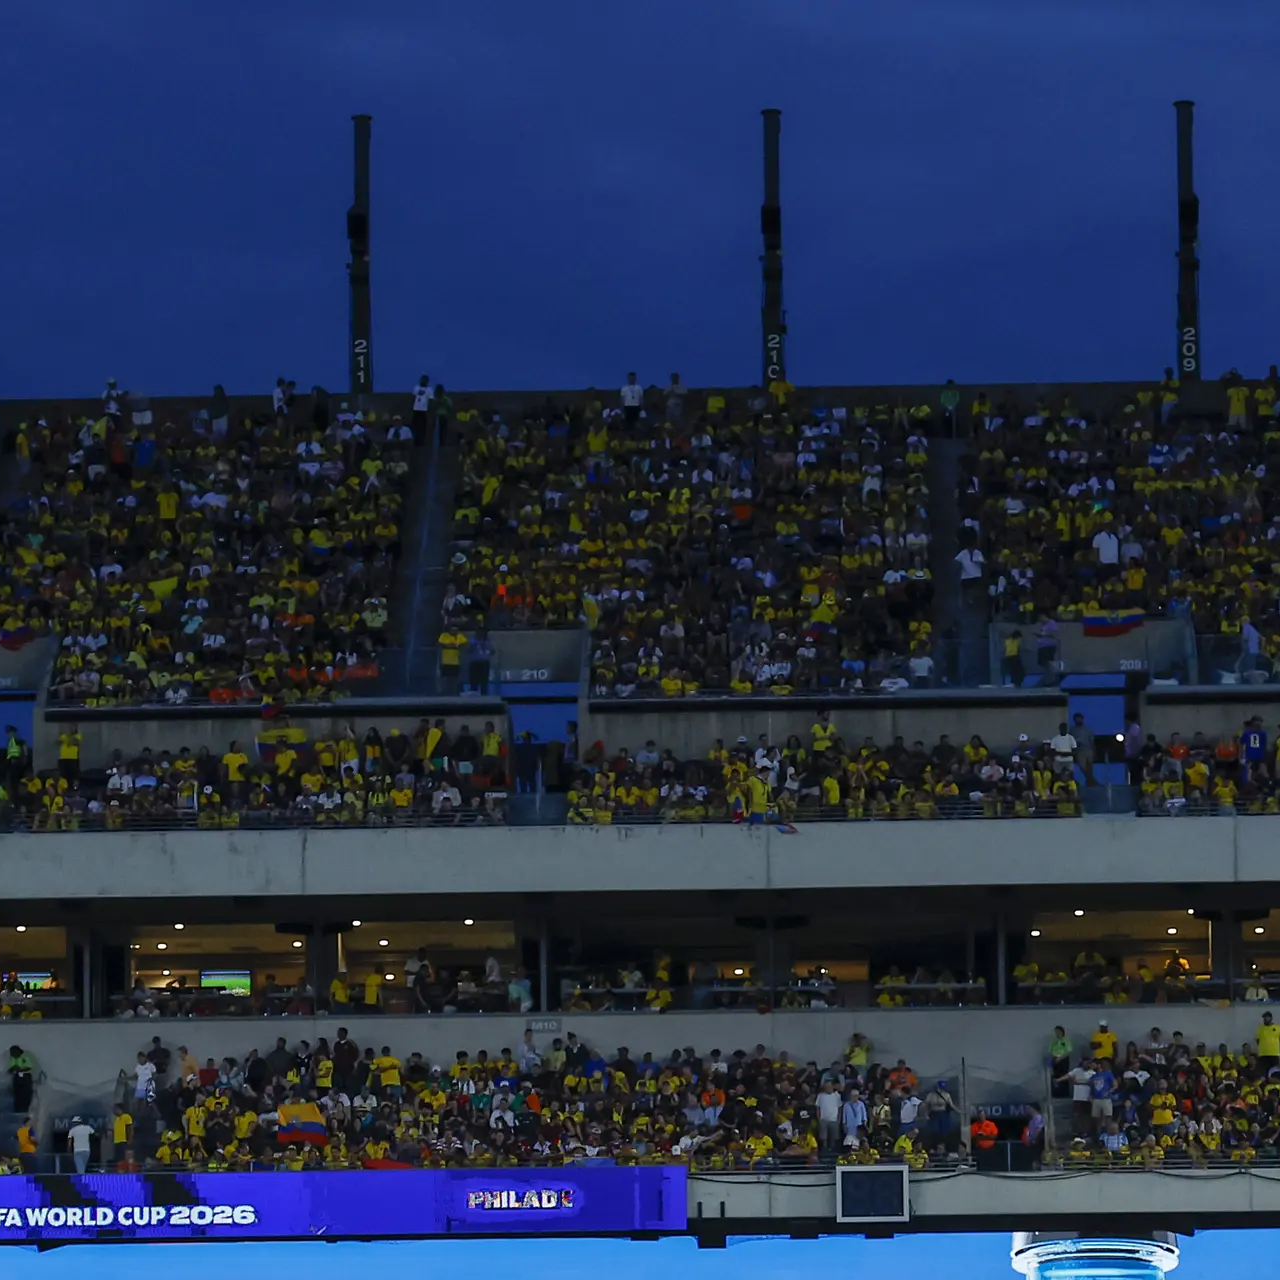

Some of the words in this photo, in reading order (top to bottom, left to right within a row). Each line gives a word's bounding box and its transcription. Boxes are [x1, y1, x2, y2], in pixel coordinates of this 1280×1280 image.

[25, 1207, 114, 1226] WORLD
[117, 1205, 166, 1226] CUP
[168, 1203, 256, 1225] 2026
